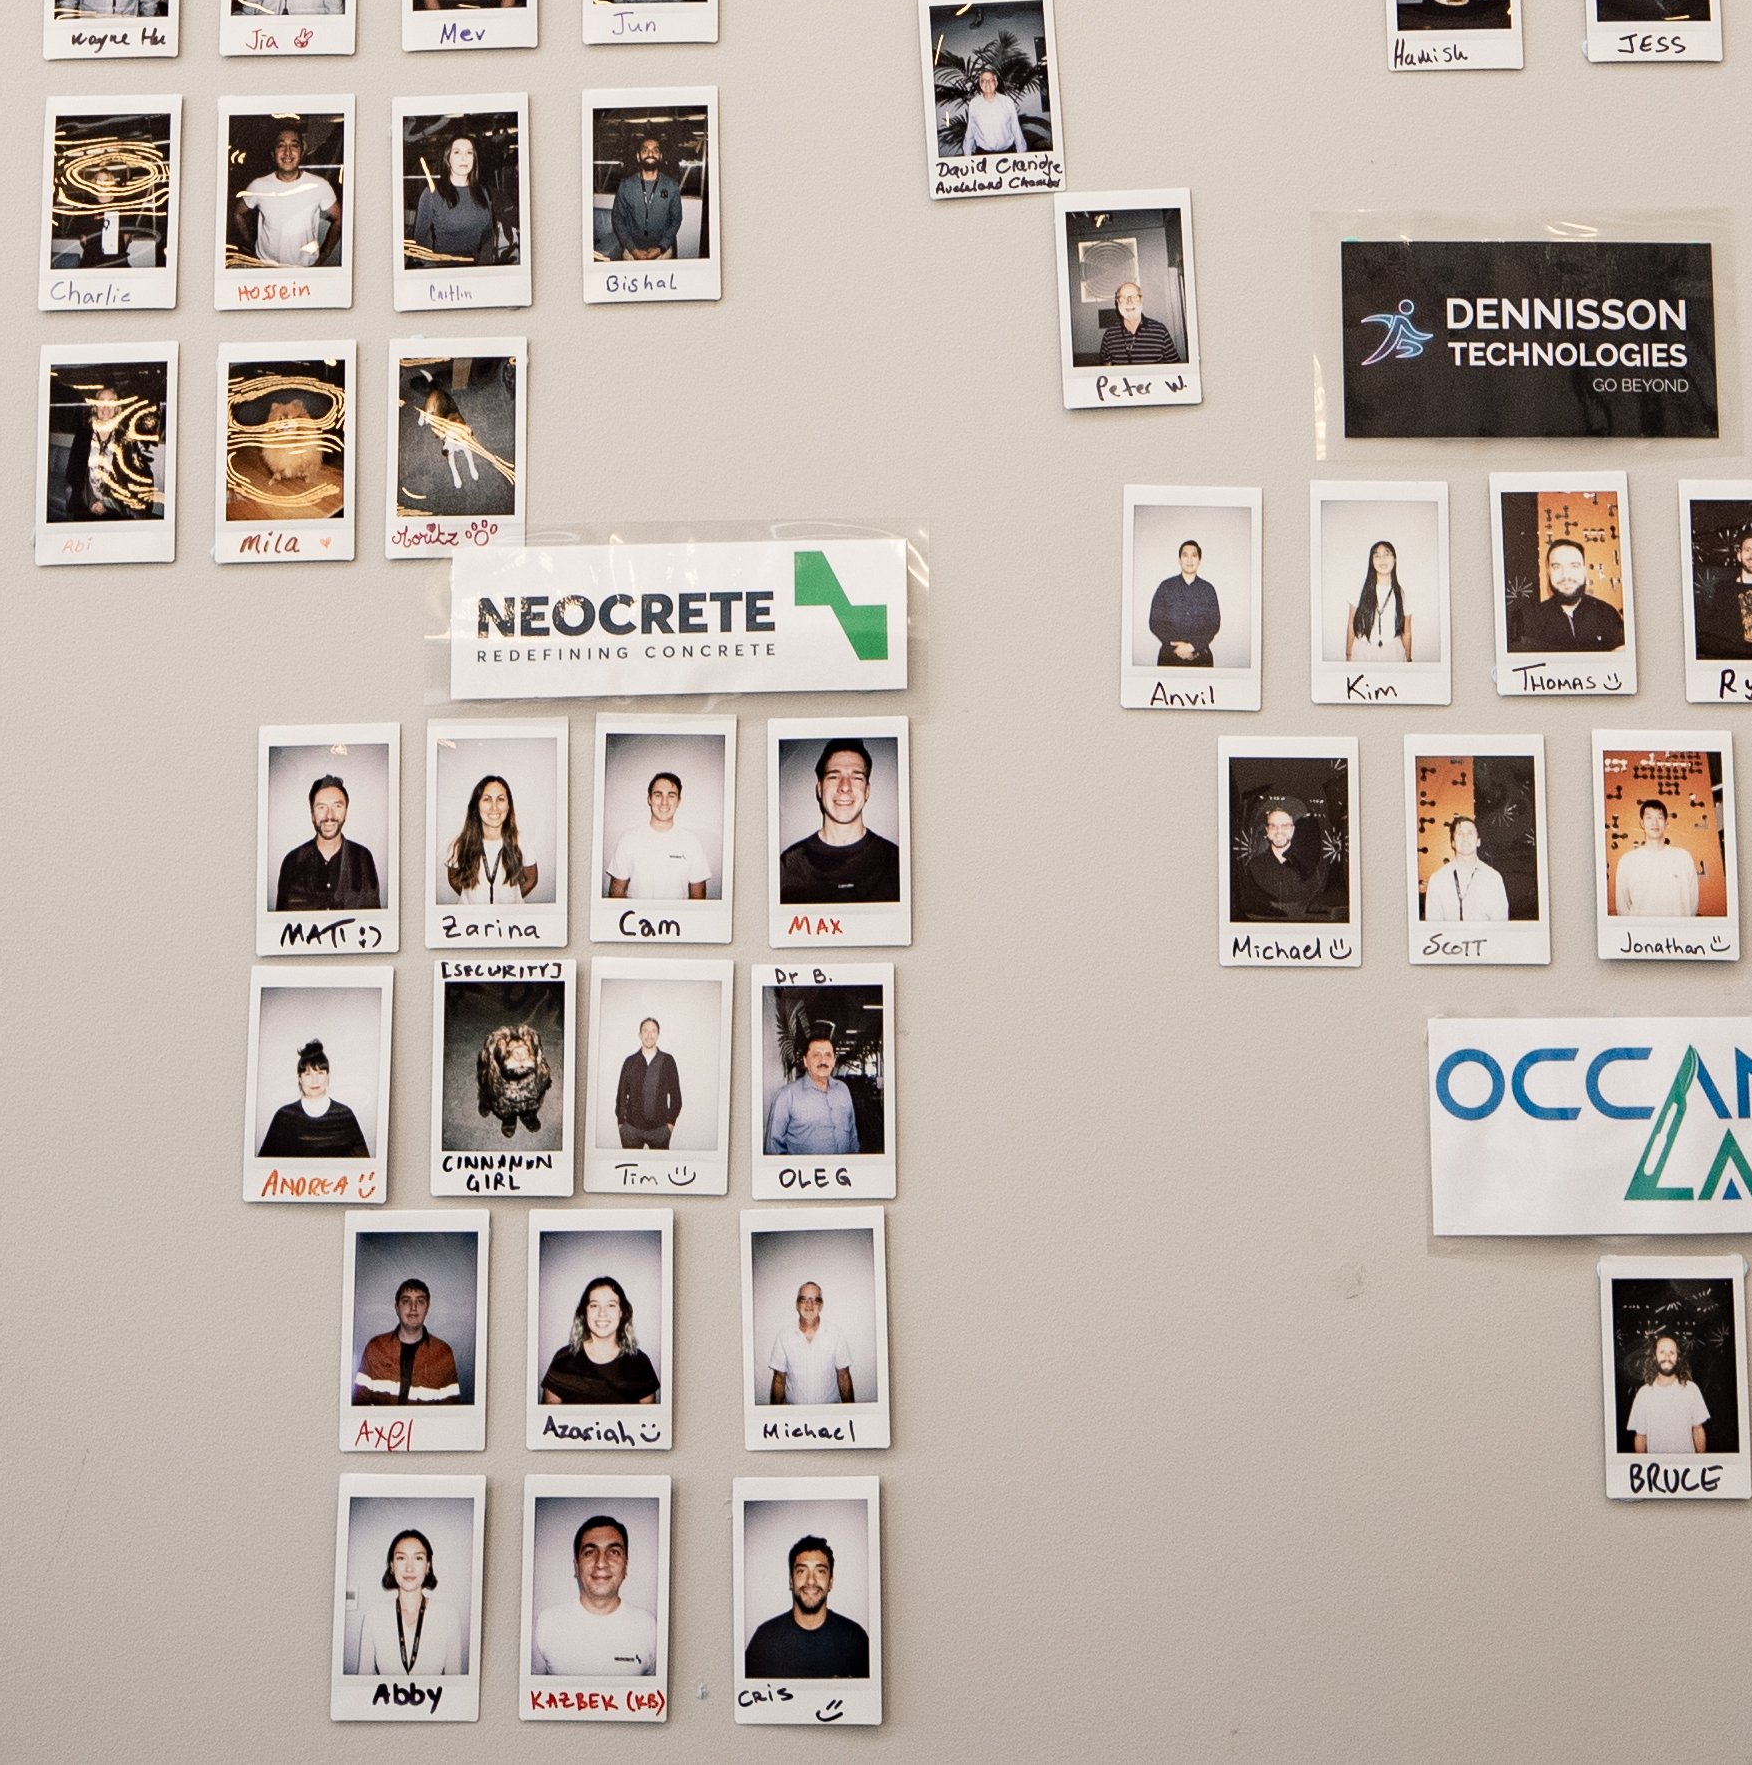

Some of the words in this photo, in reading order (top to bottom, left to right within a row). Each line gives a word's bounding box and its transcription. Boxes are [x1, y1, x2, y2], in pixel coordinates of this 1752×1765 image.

[440, 22, 486, 46] Mev
[611, 10, 657, 36] Jun
[246, 28, 280, 52] Jia
[1617, 34, 1687, 55] JESS
[935, 157, 988, 178] David
[50, 281, 132, 307] Charlie
[1446, 296, 1687, 333] DENNISSON
[1447, 339, 1689, 370] TECHNOLOGIES
[1592, 377, 1618, 394] GO
[1621, 376, 1690, 395] BEYOND
[476, 590, 777, 640] NEOCRETE
[477, 644, 630, 663] REDEFINING
[644, 642, 777, 660] CONCRETE
[1149, 682, 1216, 707] Anvil
[1346, 675, 1398, 699] Kim
[279, 917, 357, 948] MATT
[442, 914, 541, 940] Zarina
[618, 910, 681, 938] Cam
[787, 915, 844, 936] MAX
[1231, 936, 1323, 962] Michael
[1618, 934, 1707, 956] Jonathan
[260, 1171, 350, 1198] ANDREA
[466, 1172, 521, 1192] GIRL
[778, 1167, 852, 1189] OLEG
[355, 1419, 414, 1451] Axel
[544, 1415, 636, 1448] Azariah
[762, 1422, 857, 1443] Michael
[1628, 1462, 1725, 1494] BRUCE
[371, 1683, 443, 1711] Abby
[529, 1690, 619, 1715] KAZBEK
